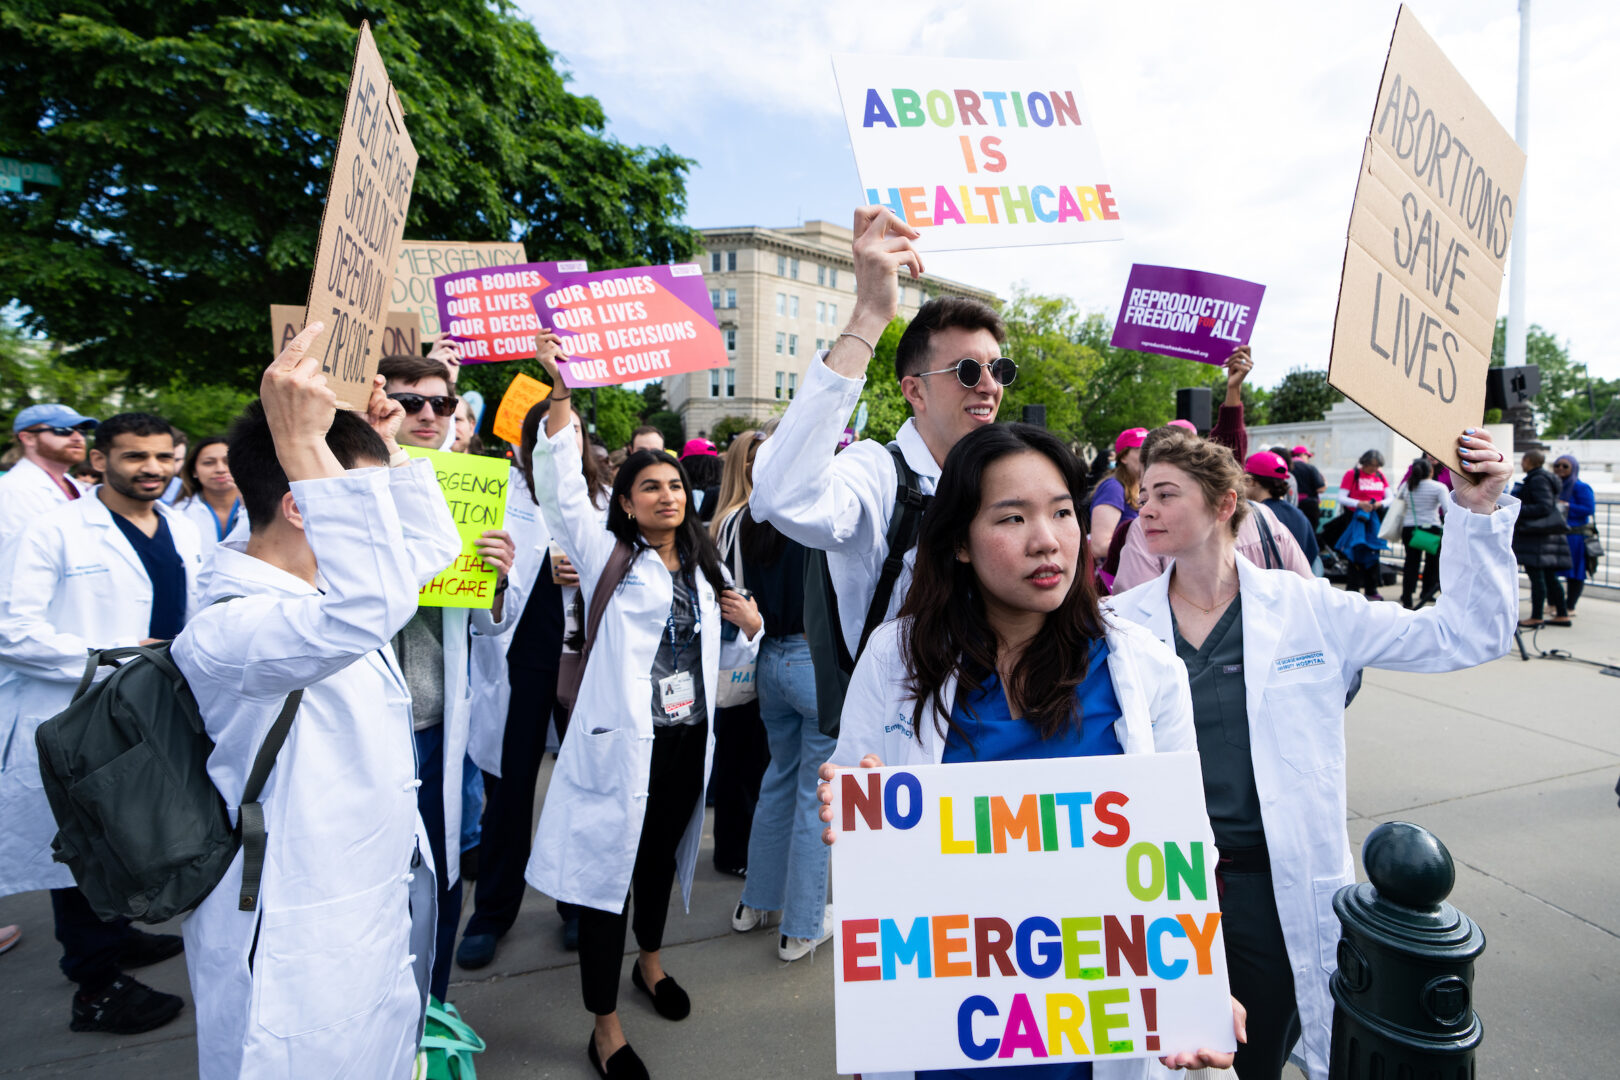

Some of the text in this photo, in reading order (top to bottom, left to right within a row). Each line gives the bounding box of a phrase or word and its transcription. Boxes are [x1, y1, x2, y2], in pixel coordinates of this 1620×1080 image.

[863, 88, 1082, 128] ABORTION
[351, 64, 412, 217] HEALTHCARE
[959, 135, 1007, 173] IS
[1377, 73, 1512, 259] ABORTIONS
[866, 184, 1120, 227] HEALTHCARE
[1394, 192, 1469, 315] SAVE
[444, 270, 541, 297] OUR BODIES
[544, 275, 656, 309] OUR BODIES
[447, 293, 530, 316] OUR LIVES
[552, 301, 648, 329] OUR LIVES
[1124, 305, 1241, 342] FREEDOM FOR ALL
[1128, 288, 1250, 325] REPRODUCTIVE
[449, 318, 486, 337] OUR
[561, 320, 697, 356] OUR DECISIONS
[1371, 272, 1459, 404] LIVES
[568, 350, 672, 381] OUR COURT
[1296, 658, 1325, 667] HOSPITAL
[841, 772, 1130, 854] NO LIMITS
[1126, 841, 1208, 902] ON
[842, 912, 1222, 982] EMERGENCY
[957, 988, 1161, 1061] CARE!
